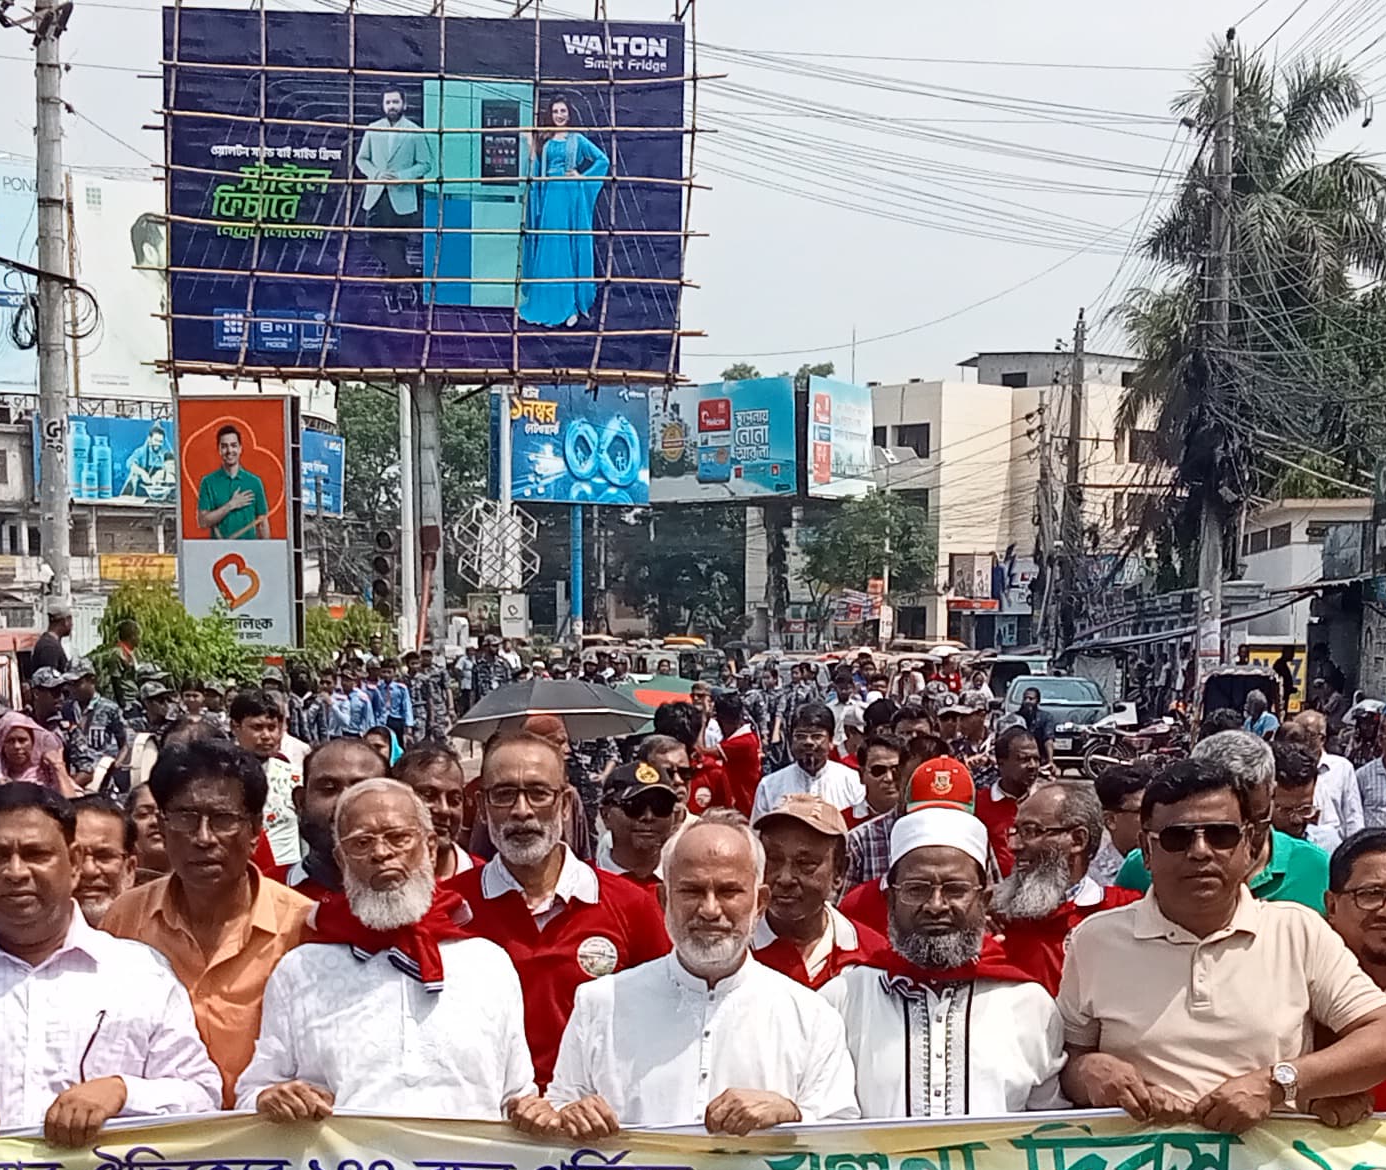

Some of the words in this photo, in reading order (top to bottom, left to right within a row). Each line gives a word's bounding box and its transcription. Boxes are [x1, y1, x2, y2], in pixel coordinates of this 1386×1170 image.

[562, 34, 668, 58] WALTON
[584, 56, 624, 70] Smart
[627, 59, 668, 73] Fridge
